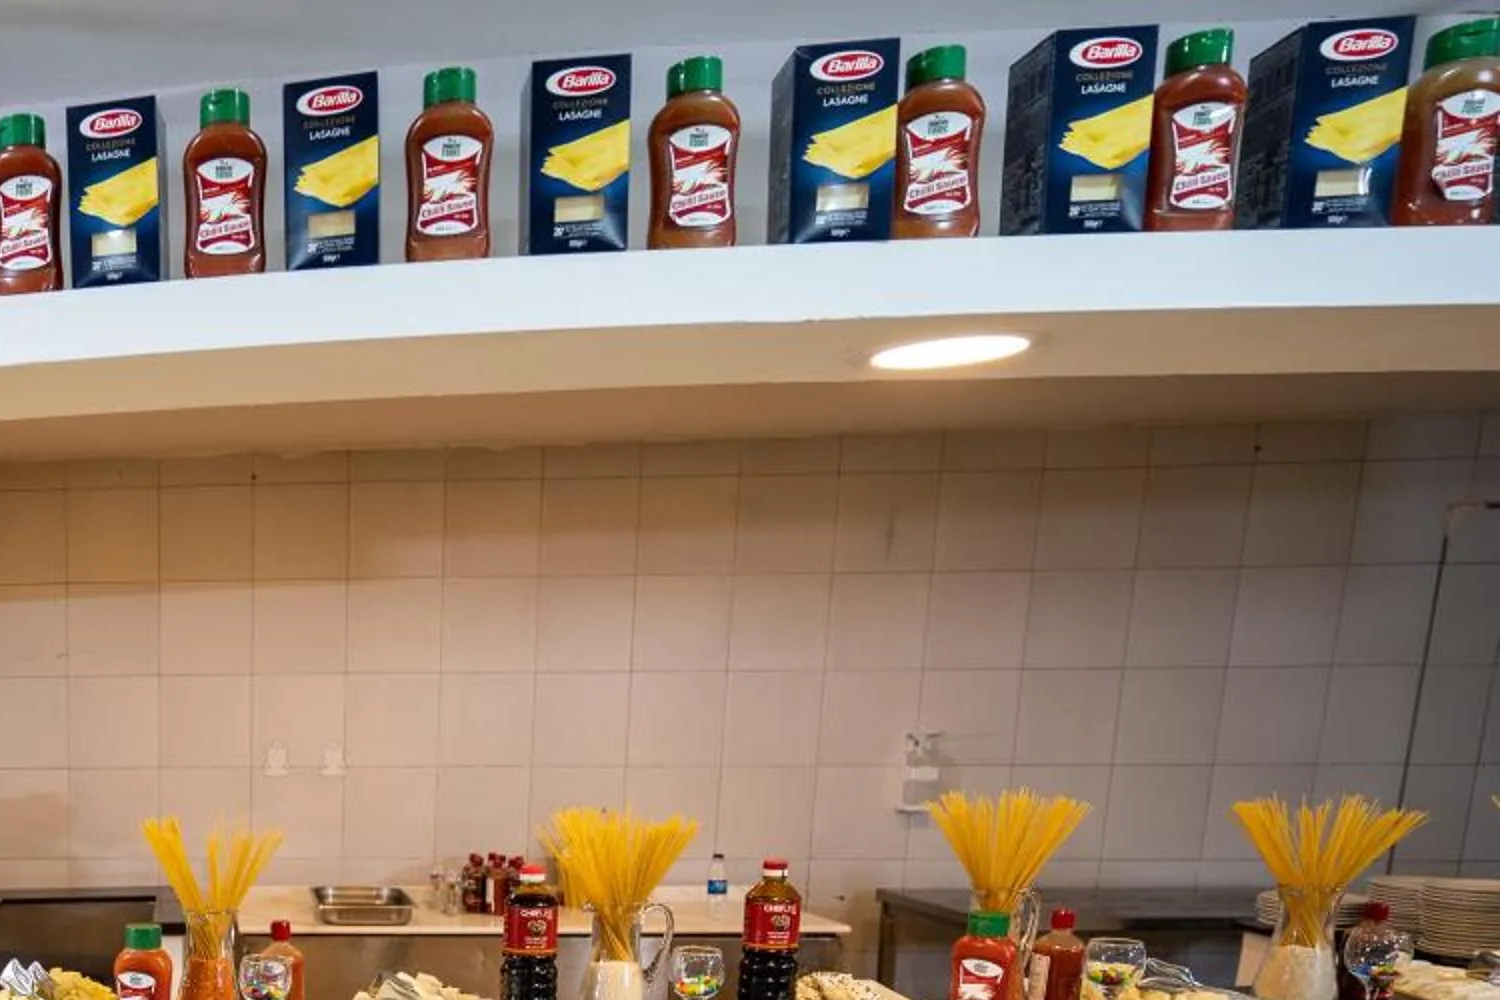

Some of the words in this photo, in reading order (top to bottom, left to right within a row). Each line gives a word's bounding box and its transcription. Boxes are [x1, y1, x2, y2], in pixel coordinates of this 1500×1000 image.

[1331, 75, 1379, 88] LASAGNE
[1081, 82, 1127, 95] LASAGNE
[823, 94, 870, 107] LASAGNE
[558, 108, 603, 121] LASAGNE
[309, 126, 352, 141] LASAGNE
